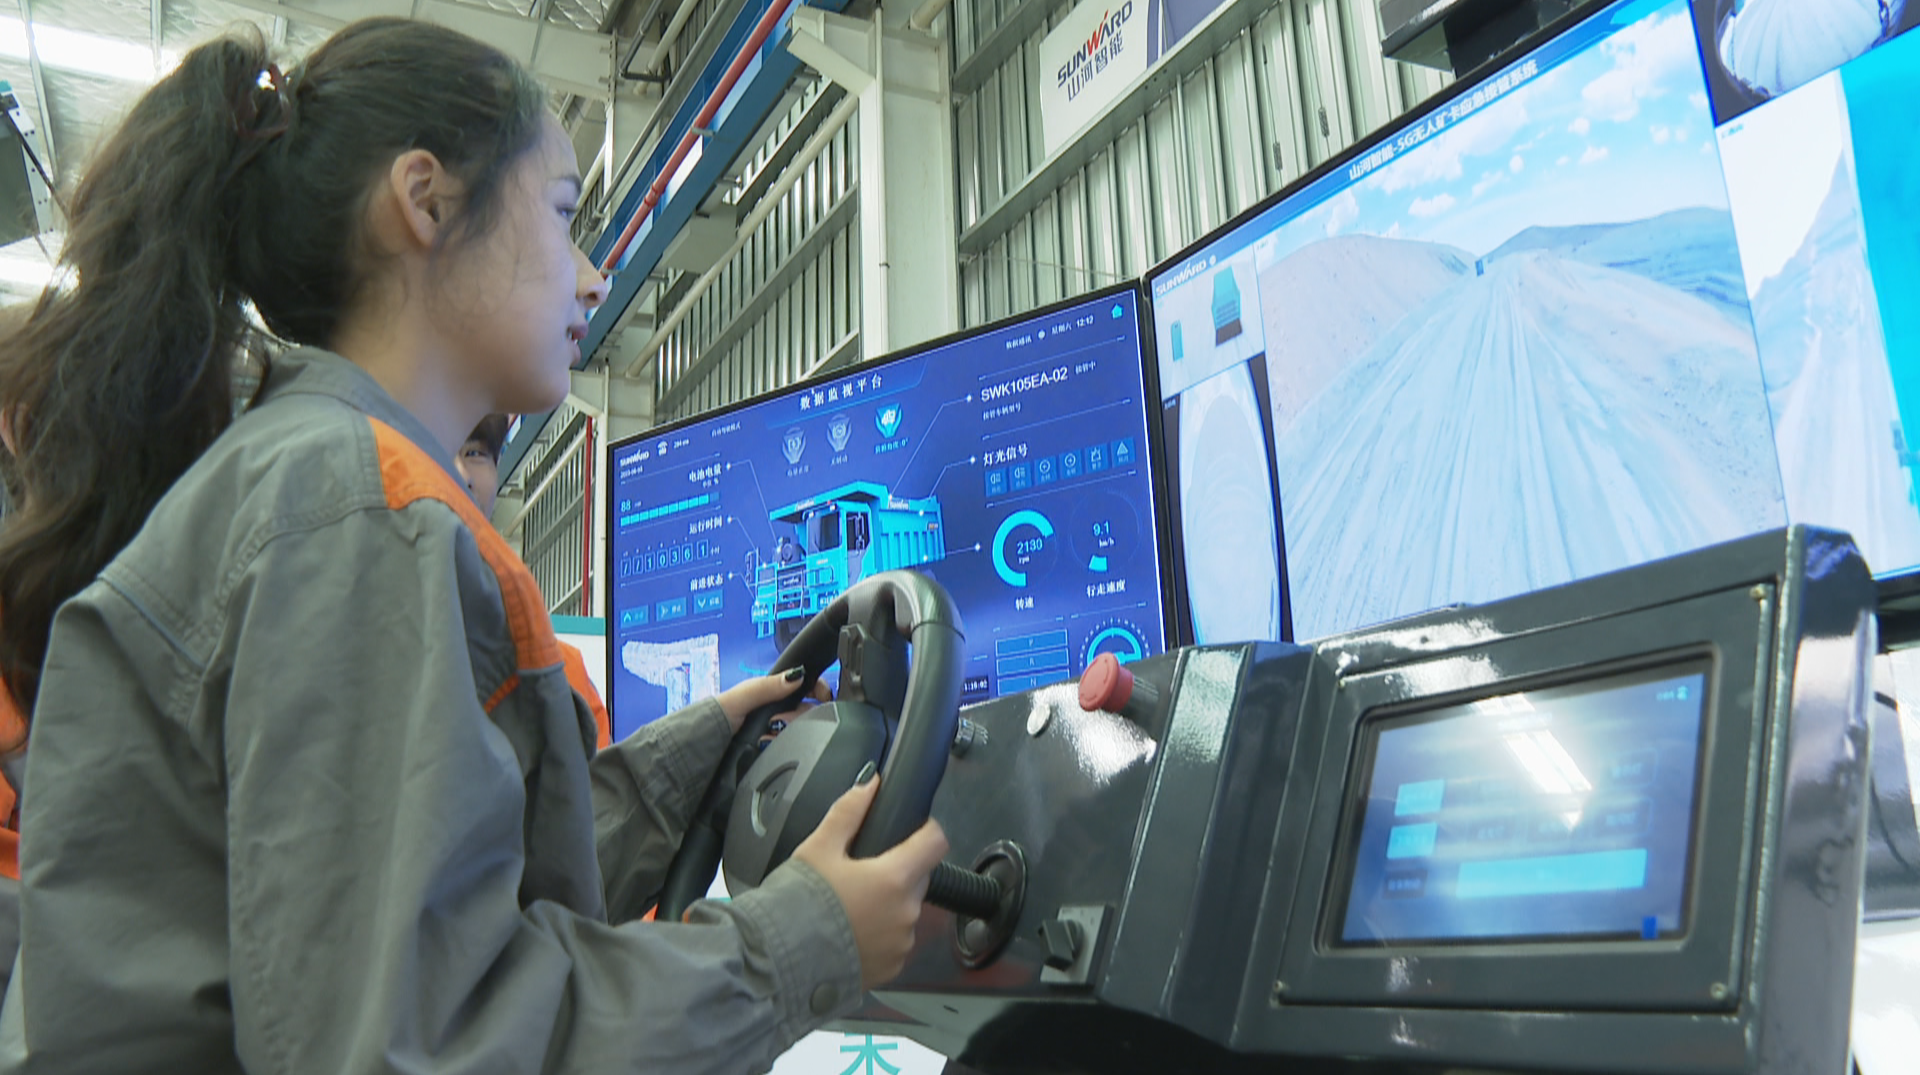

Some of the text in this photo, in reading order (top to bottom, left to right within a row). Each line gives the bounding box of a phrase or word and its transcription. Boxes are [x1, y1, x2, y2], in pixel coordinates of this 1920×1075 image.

[1057, 1, 1133, 88] SUNWARD
[1067, 30, 1124, 102] 山河智能
[1156, 262, 1207, 297] SUNWARD
[800, 373, 883, 411] 数据监视平台
[981, 366, 1069, 402] SWK105EA-02
[983, 442, 1028, 467] 灯光信号
[689, 463, 721, 483] 电池电量
[621, 500, 631, 512] 88
[689, 515, 723, 535] 运行时间
[1093, 521, 1110, 536] 9.1
[690, 573, 723, 592] 前进状态
[1086, 578, 1127, 598] 行走速度
[1015, 596, 1034, 612] 转速
